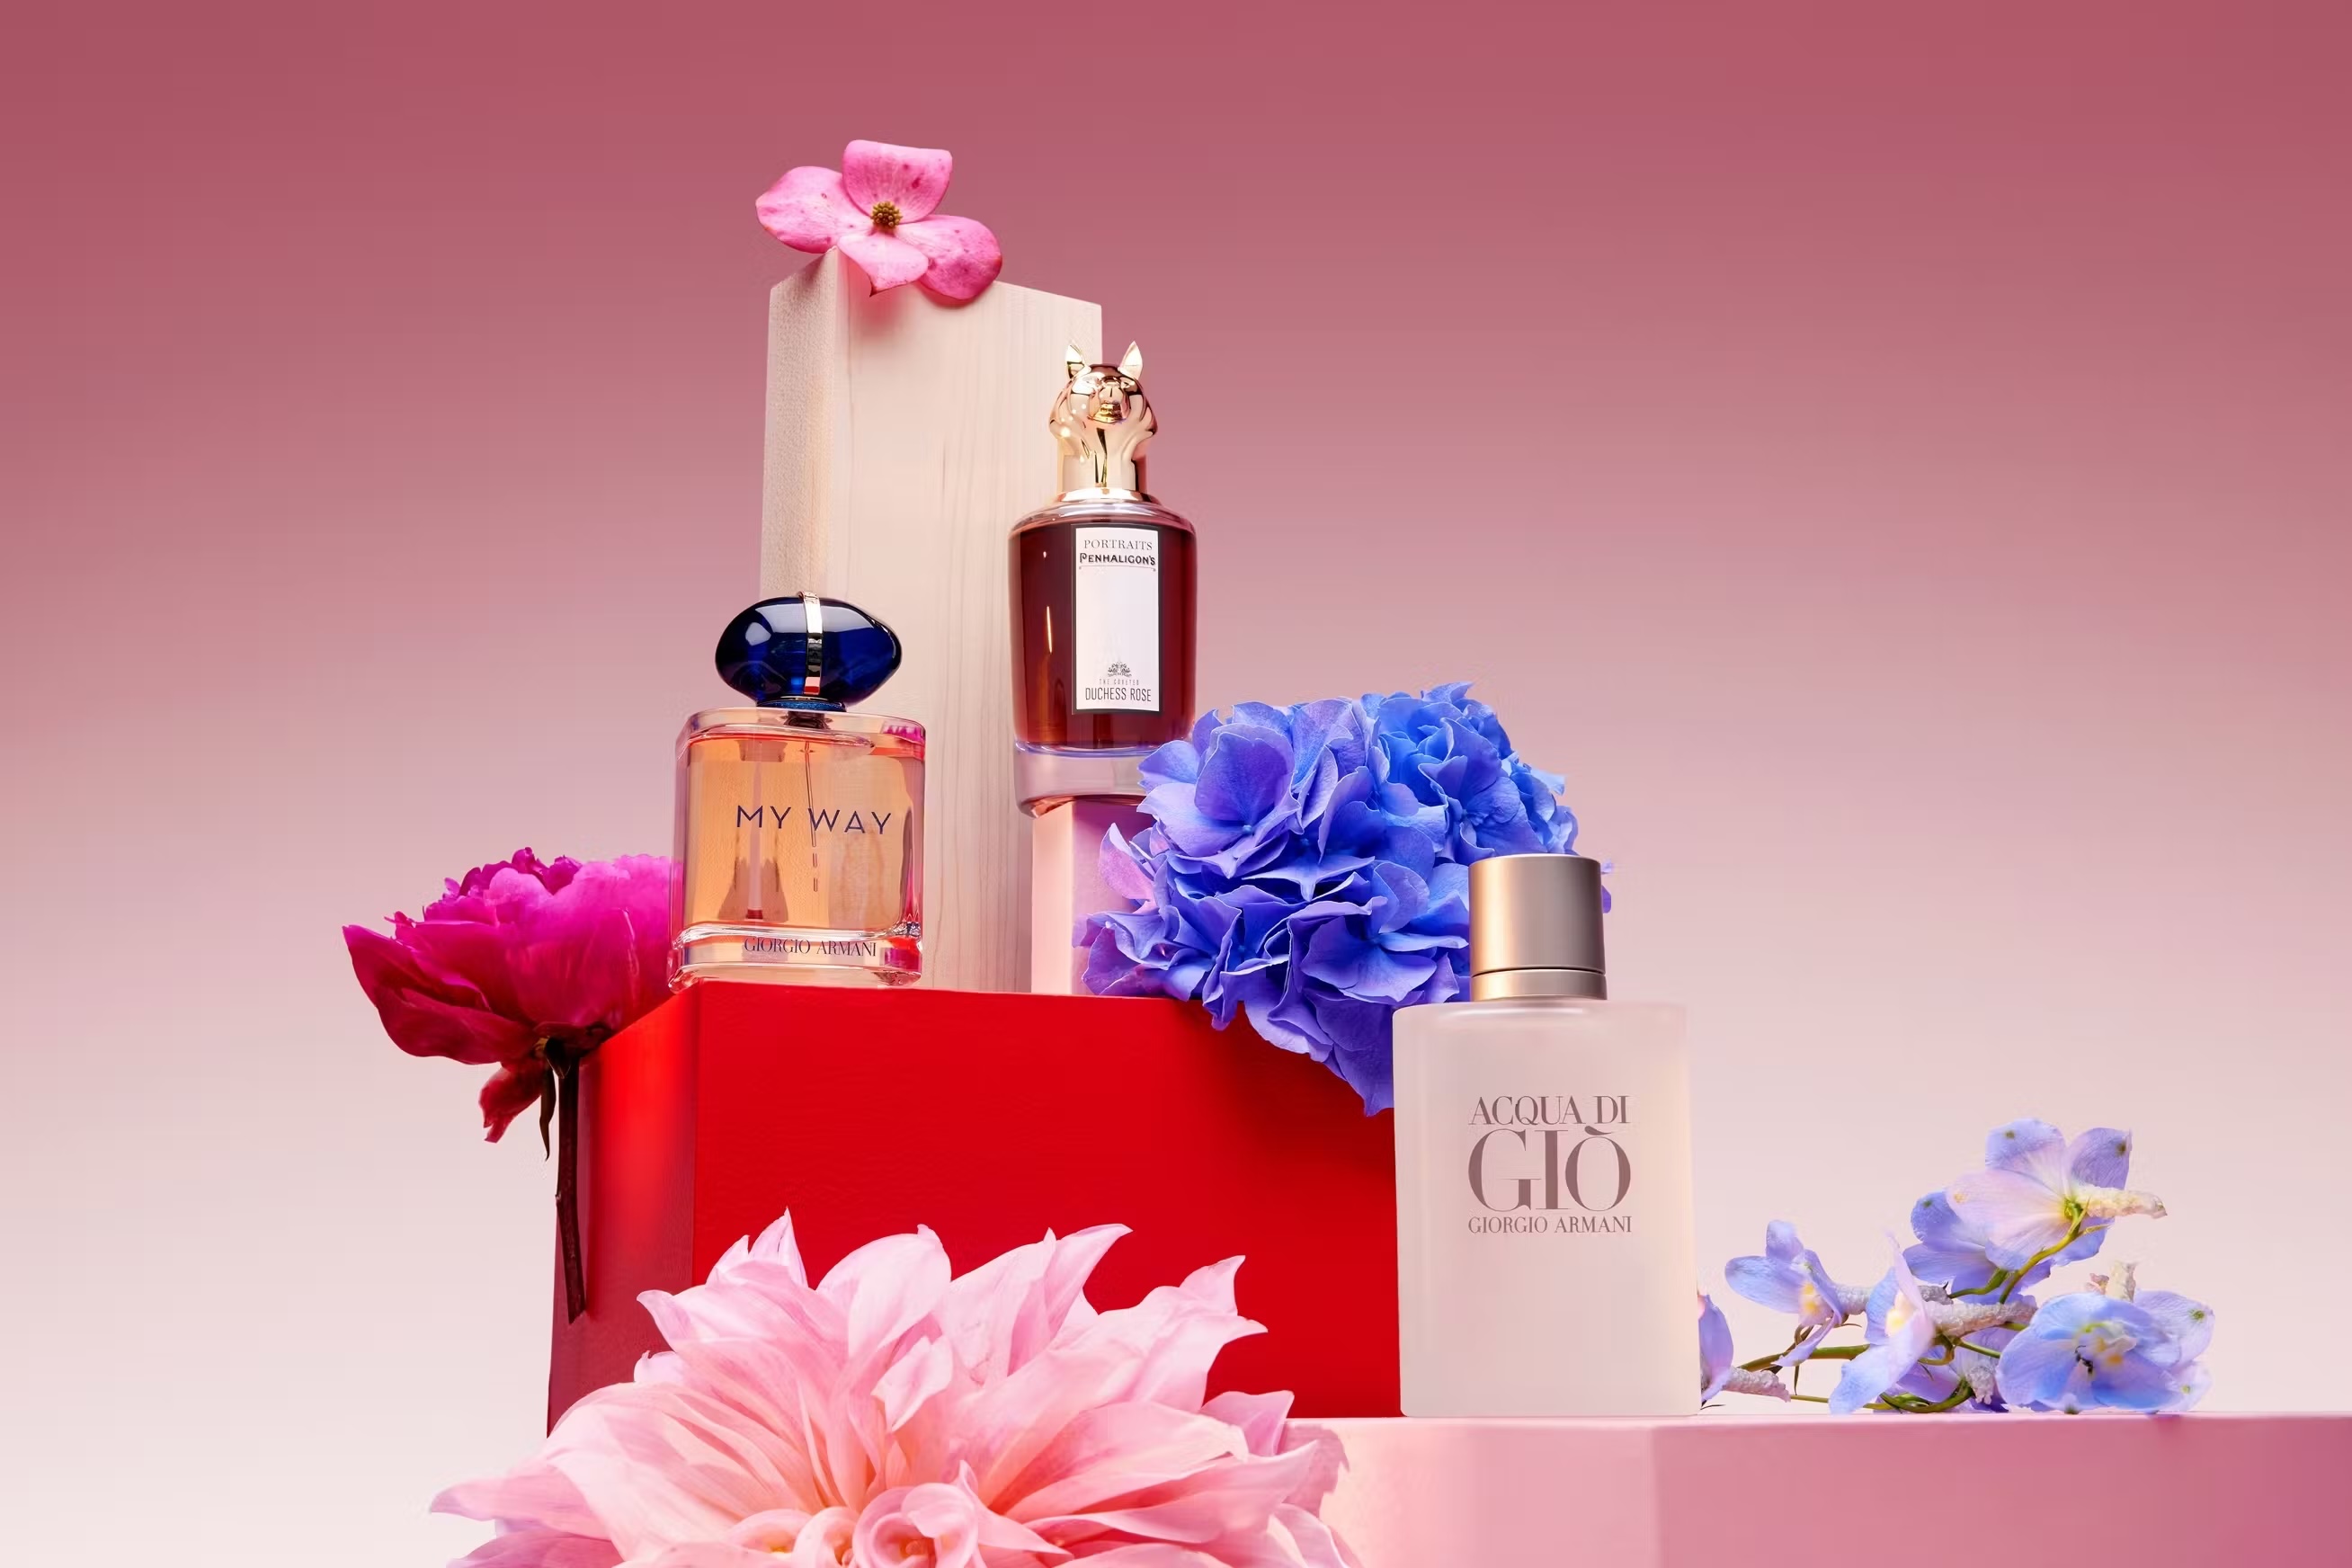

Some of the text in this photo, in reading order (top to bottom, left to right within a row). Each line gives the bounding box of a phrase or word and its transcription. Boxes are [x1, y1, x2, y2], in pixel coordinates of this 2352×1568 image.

[1084, 539, 1153, 550] PORTRAITS
[1080, 552, 1155, 566] PENHALIGON'S
[1085, 687, 1152, 702] DUCHESS ROSE
[736, 806, 892, 835] MY WAY
[744, 937, 878, 957] GIORGIO ARMANI
[1468, 1095, 1631, 1126] ACQUA DI
[1467, 1125, 1632, 1212] GIÒ
[1467, 1216, 1632, 1234] GIORGIO ARMANI
